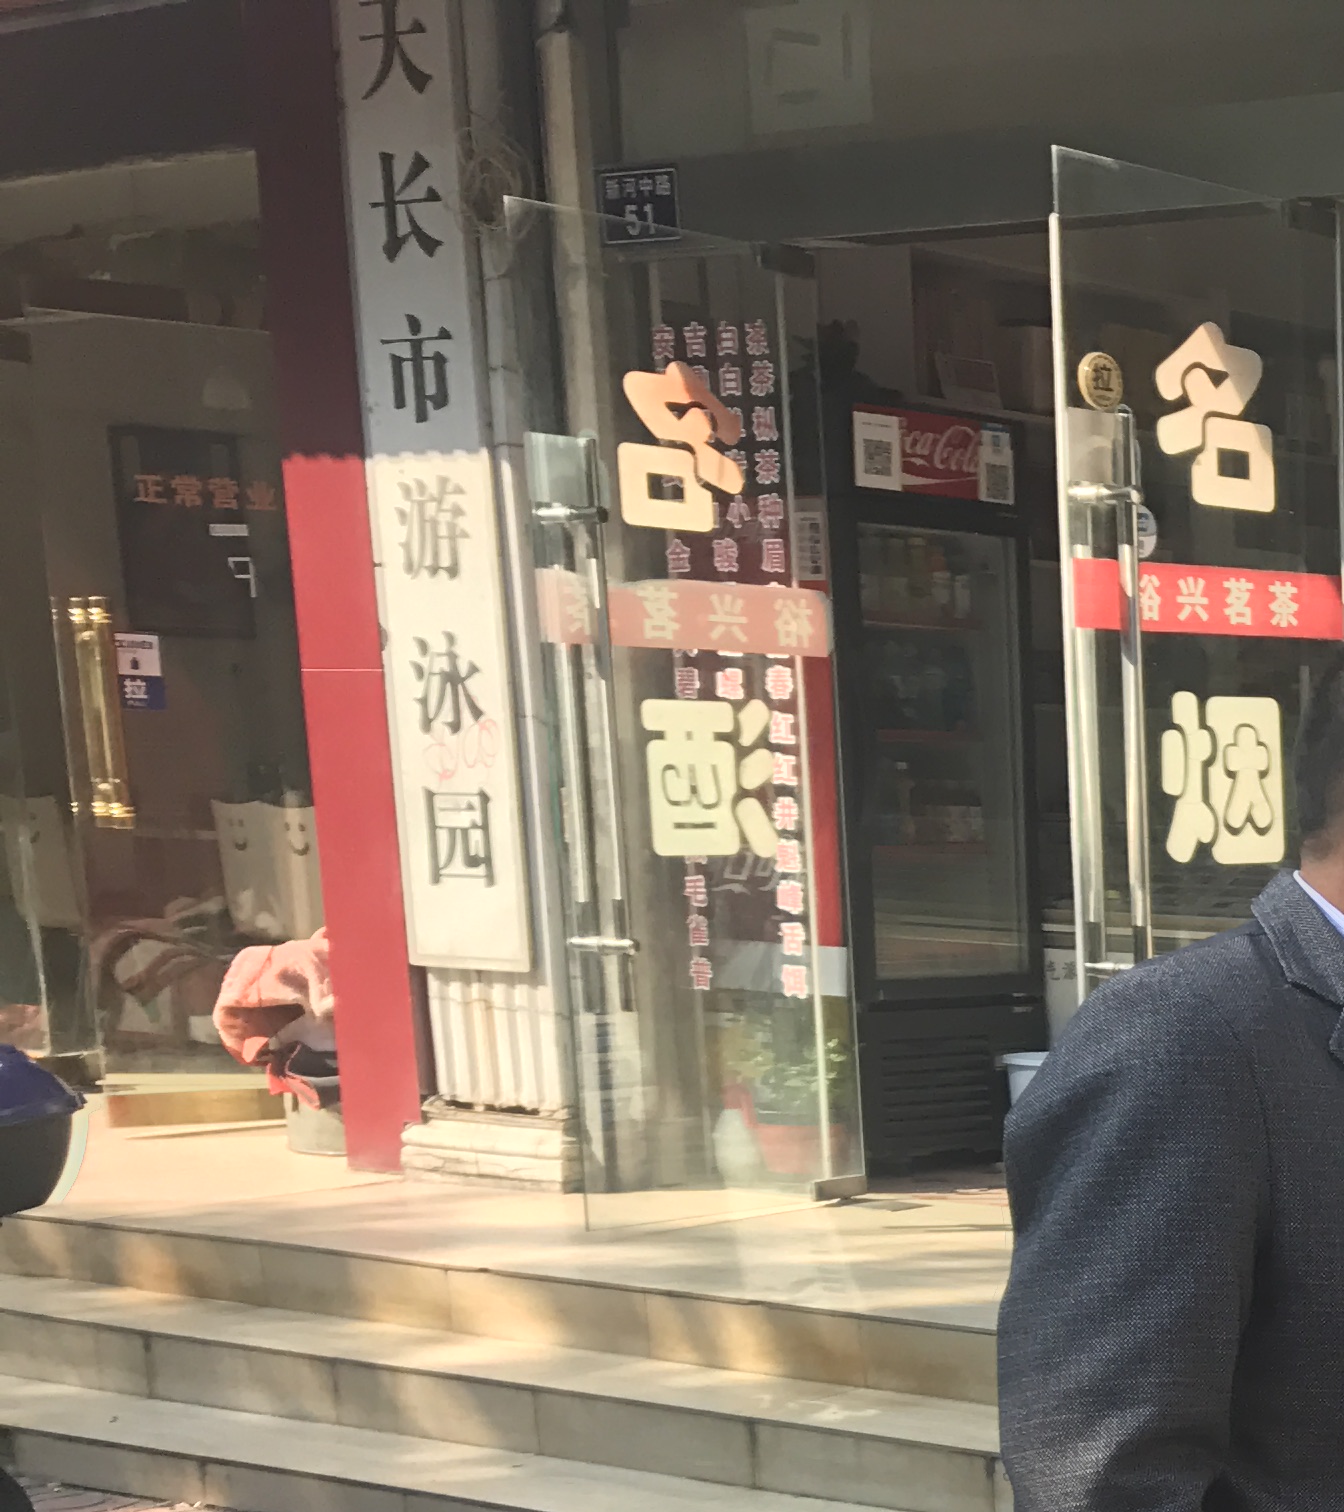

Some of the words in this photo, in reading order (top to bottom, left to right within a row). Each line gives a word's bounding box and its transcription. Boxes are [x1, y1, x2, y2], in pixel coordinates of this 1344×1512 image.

[625, 203, 655, 236] 51
[1093, 365, 1114, 392] 拉
[1155, 322, 1275, 513] 名
[134, 474, 277, 512] 正常营业
[359, 0, 495, 888] 天长市游泳园
[1161, 691, 1286, 864] 烟
